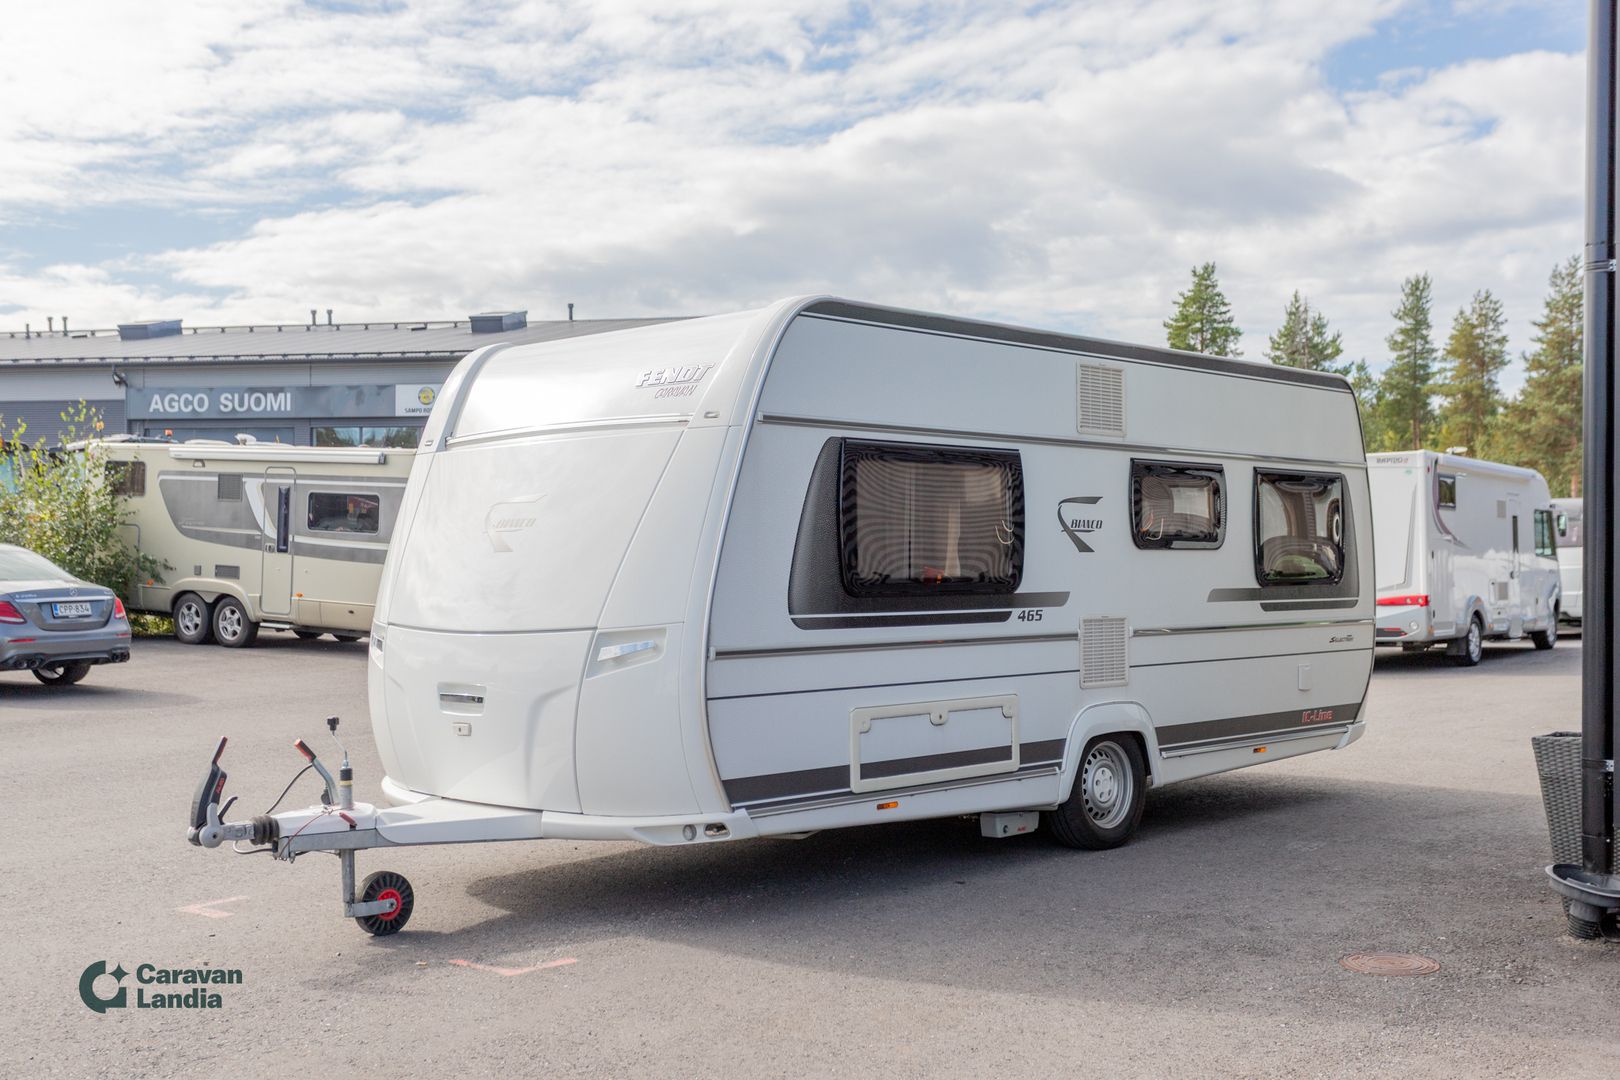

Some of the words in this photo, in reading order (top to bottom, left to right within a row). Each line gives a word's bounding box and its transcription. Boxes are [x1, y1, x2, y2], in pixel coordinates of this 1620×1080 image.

[635, 363, 716, 388] FENDT
[149, 393, 210, 413] AGCO
[219, 392, 292, 412] SUOMI
[1070, 519, 1103, 529] BIANCO
[59, 603, 90, 614] CPP-834
[1017, 609, 1044, 622] 465
